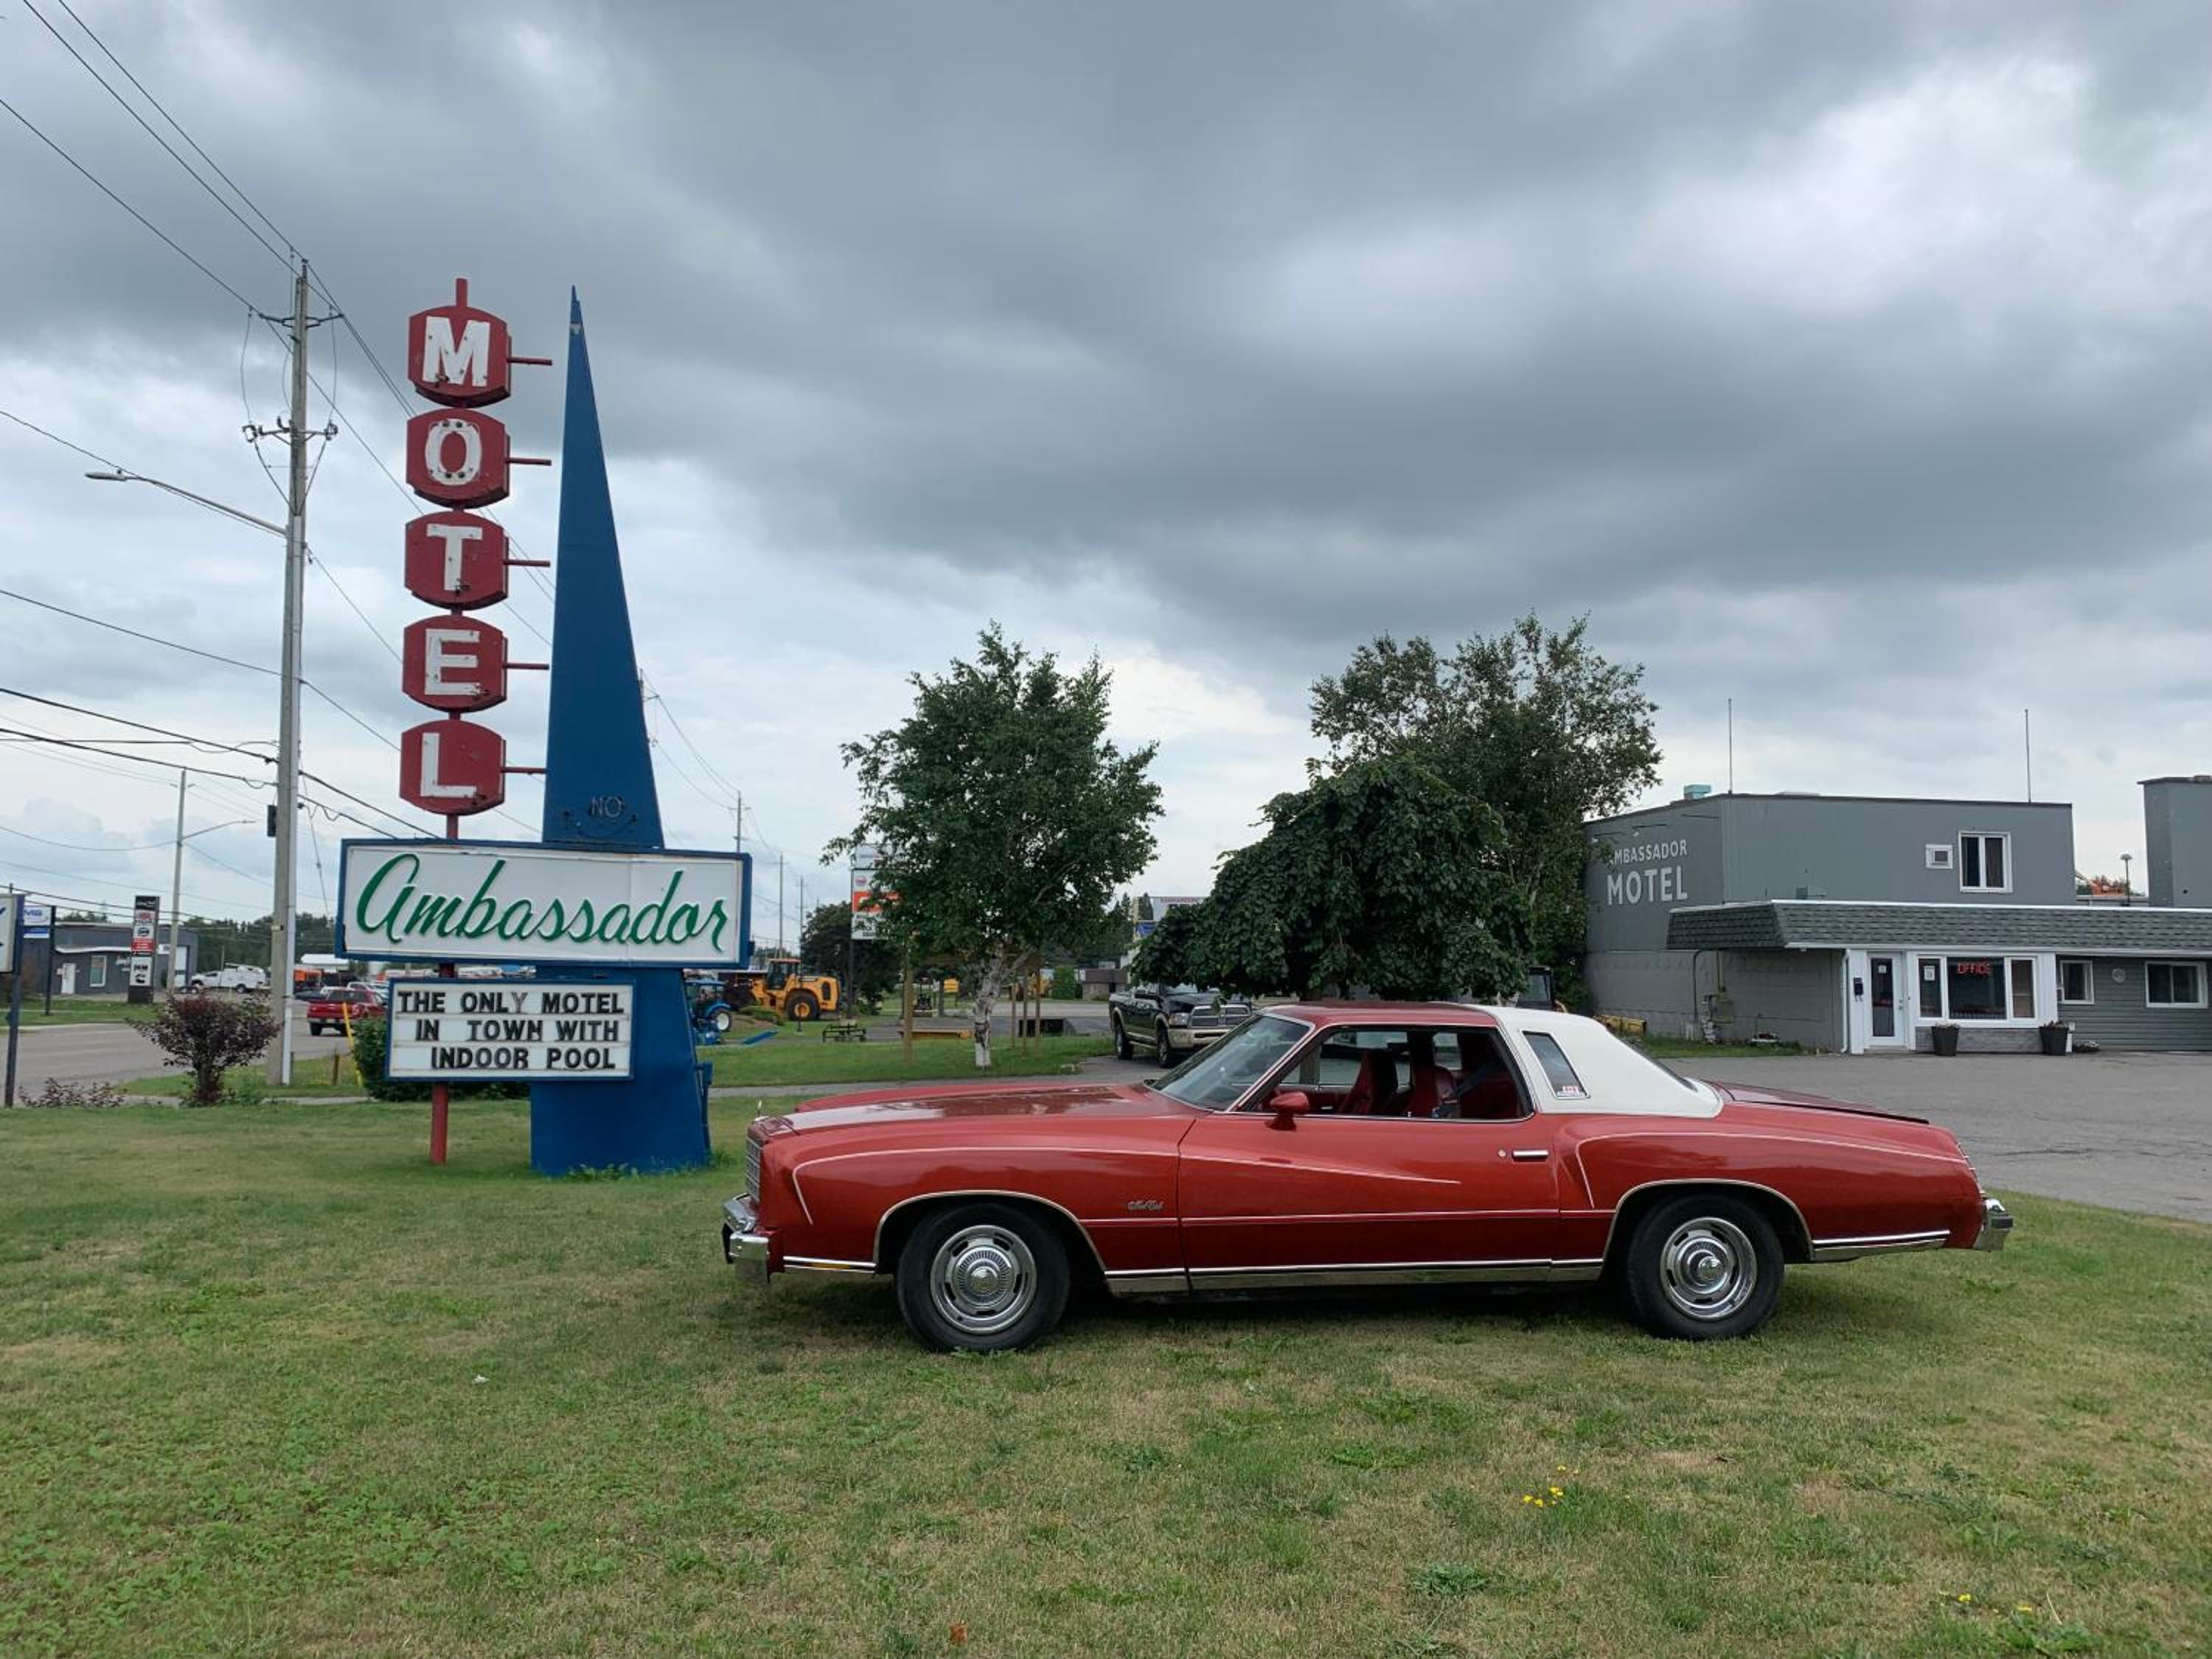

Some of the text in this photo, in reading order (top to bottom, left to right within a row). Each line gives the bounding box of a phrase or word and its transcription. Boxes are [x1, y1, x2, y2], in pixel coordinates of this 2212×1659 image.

[420, 316, 490, 798] MOTEL
[591, 796, 622, 818] NO
[1607, 866, 1688, 905] MOTEL
[356, 853, 728, 953] Ambassador
[1958, 961, 1991, 974] OFFICE
[397, 992, 625, 1014] THE ONLY MOTEL
[416, 1019, 619, 1042] IN TOWN WITH
[431, 1047, 616, 1069] INDOOR POOL
